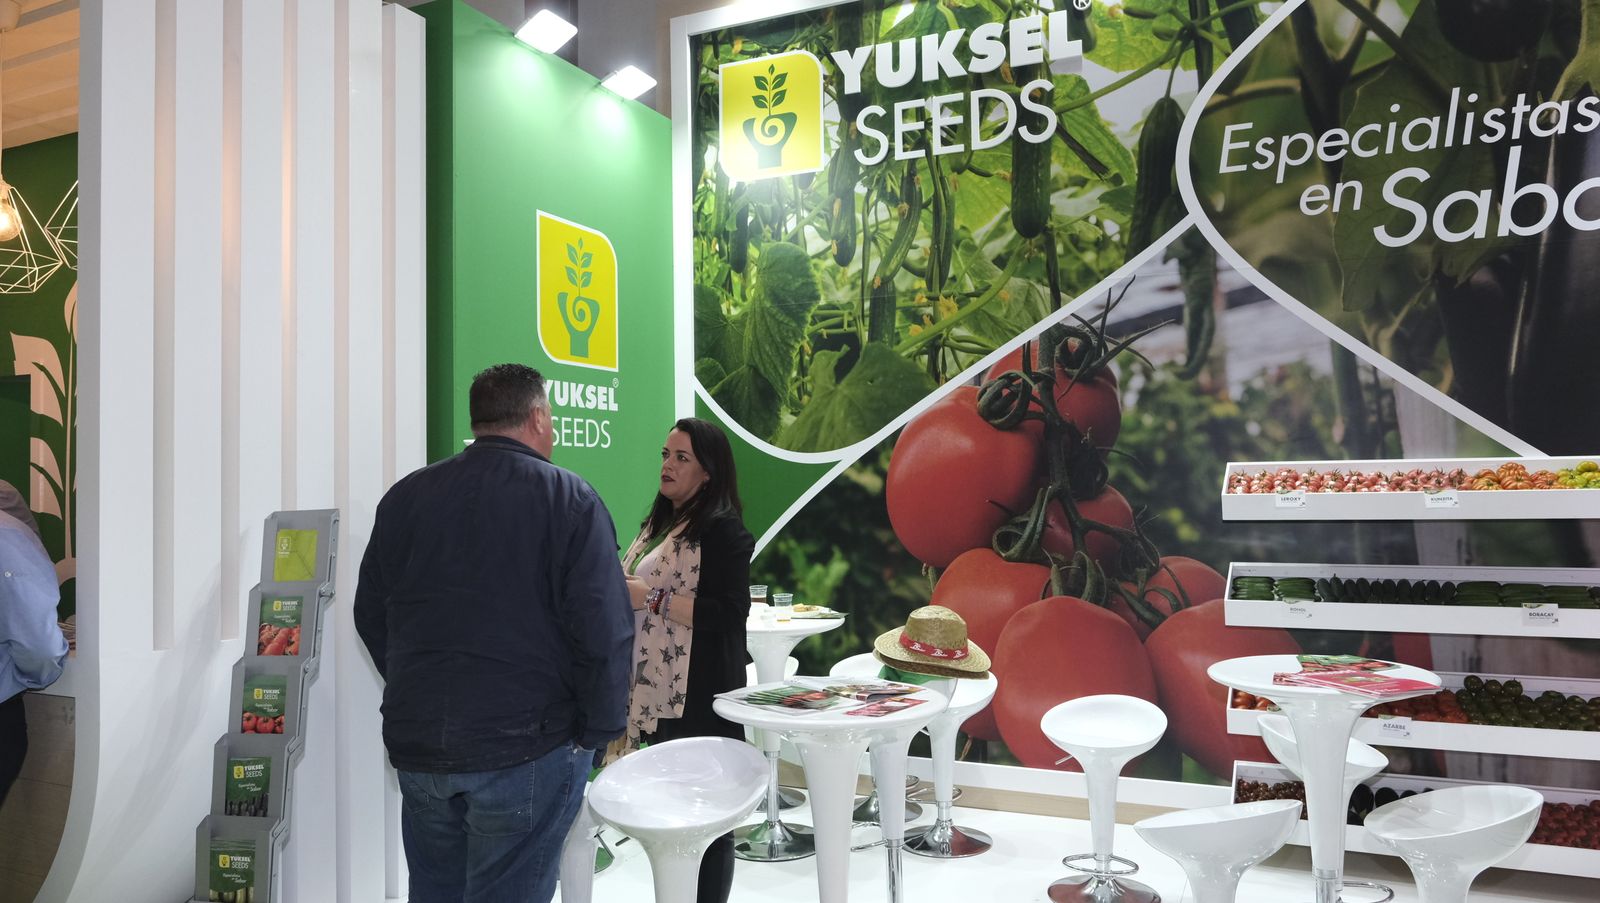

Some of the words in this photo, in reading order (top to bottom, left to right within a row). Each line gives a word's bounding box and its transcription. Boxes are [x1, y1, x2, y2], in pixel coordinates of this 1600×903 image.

[832, 10, 1082, 95] YUKSEL
[853, 79, 1057, 166] SEEDS
[1218, 87, 1600, 184] Especialistas
[1299, 179, 1363, 216] en
